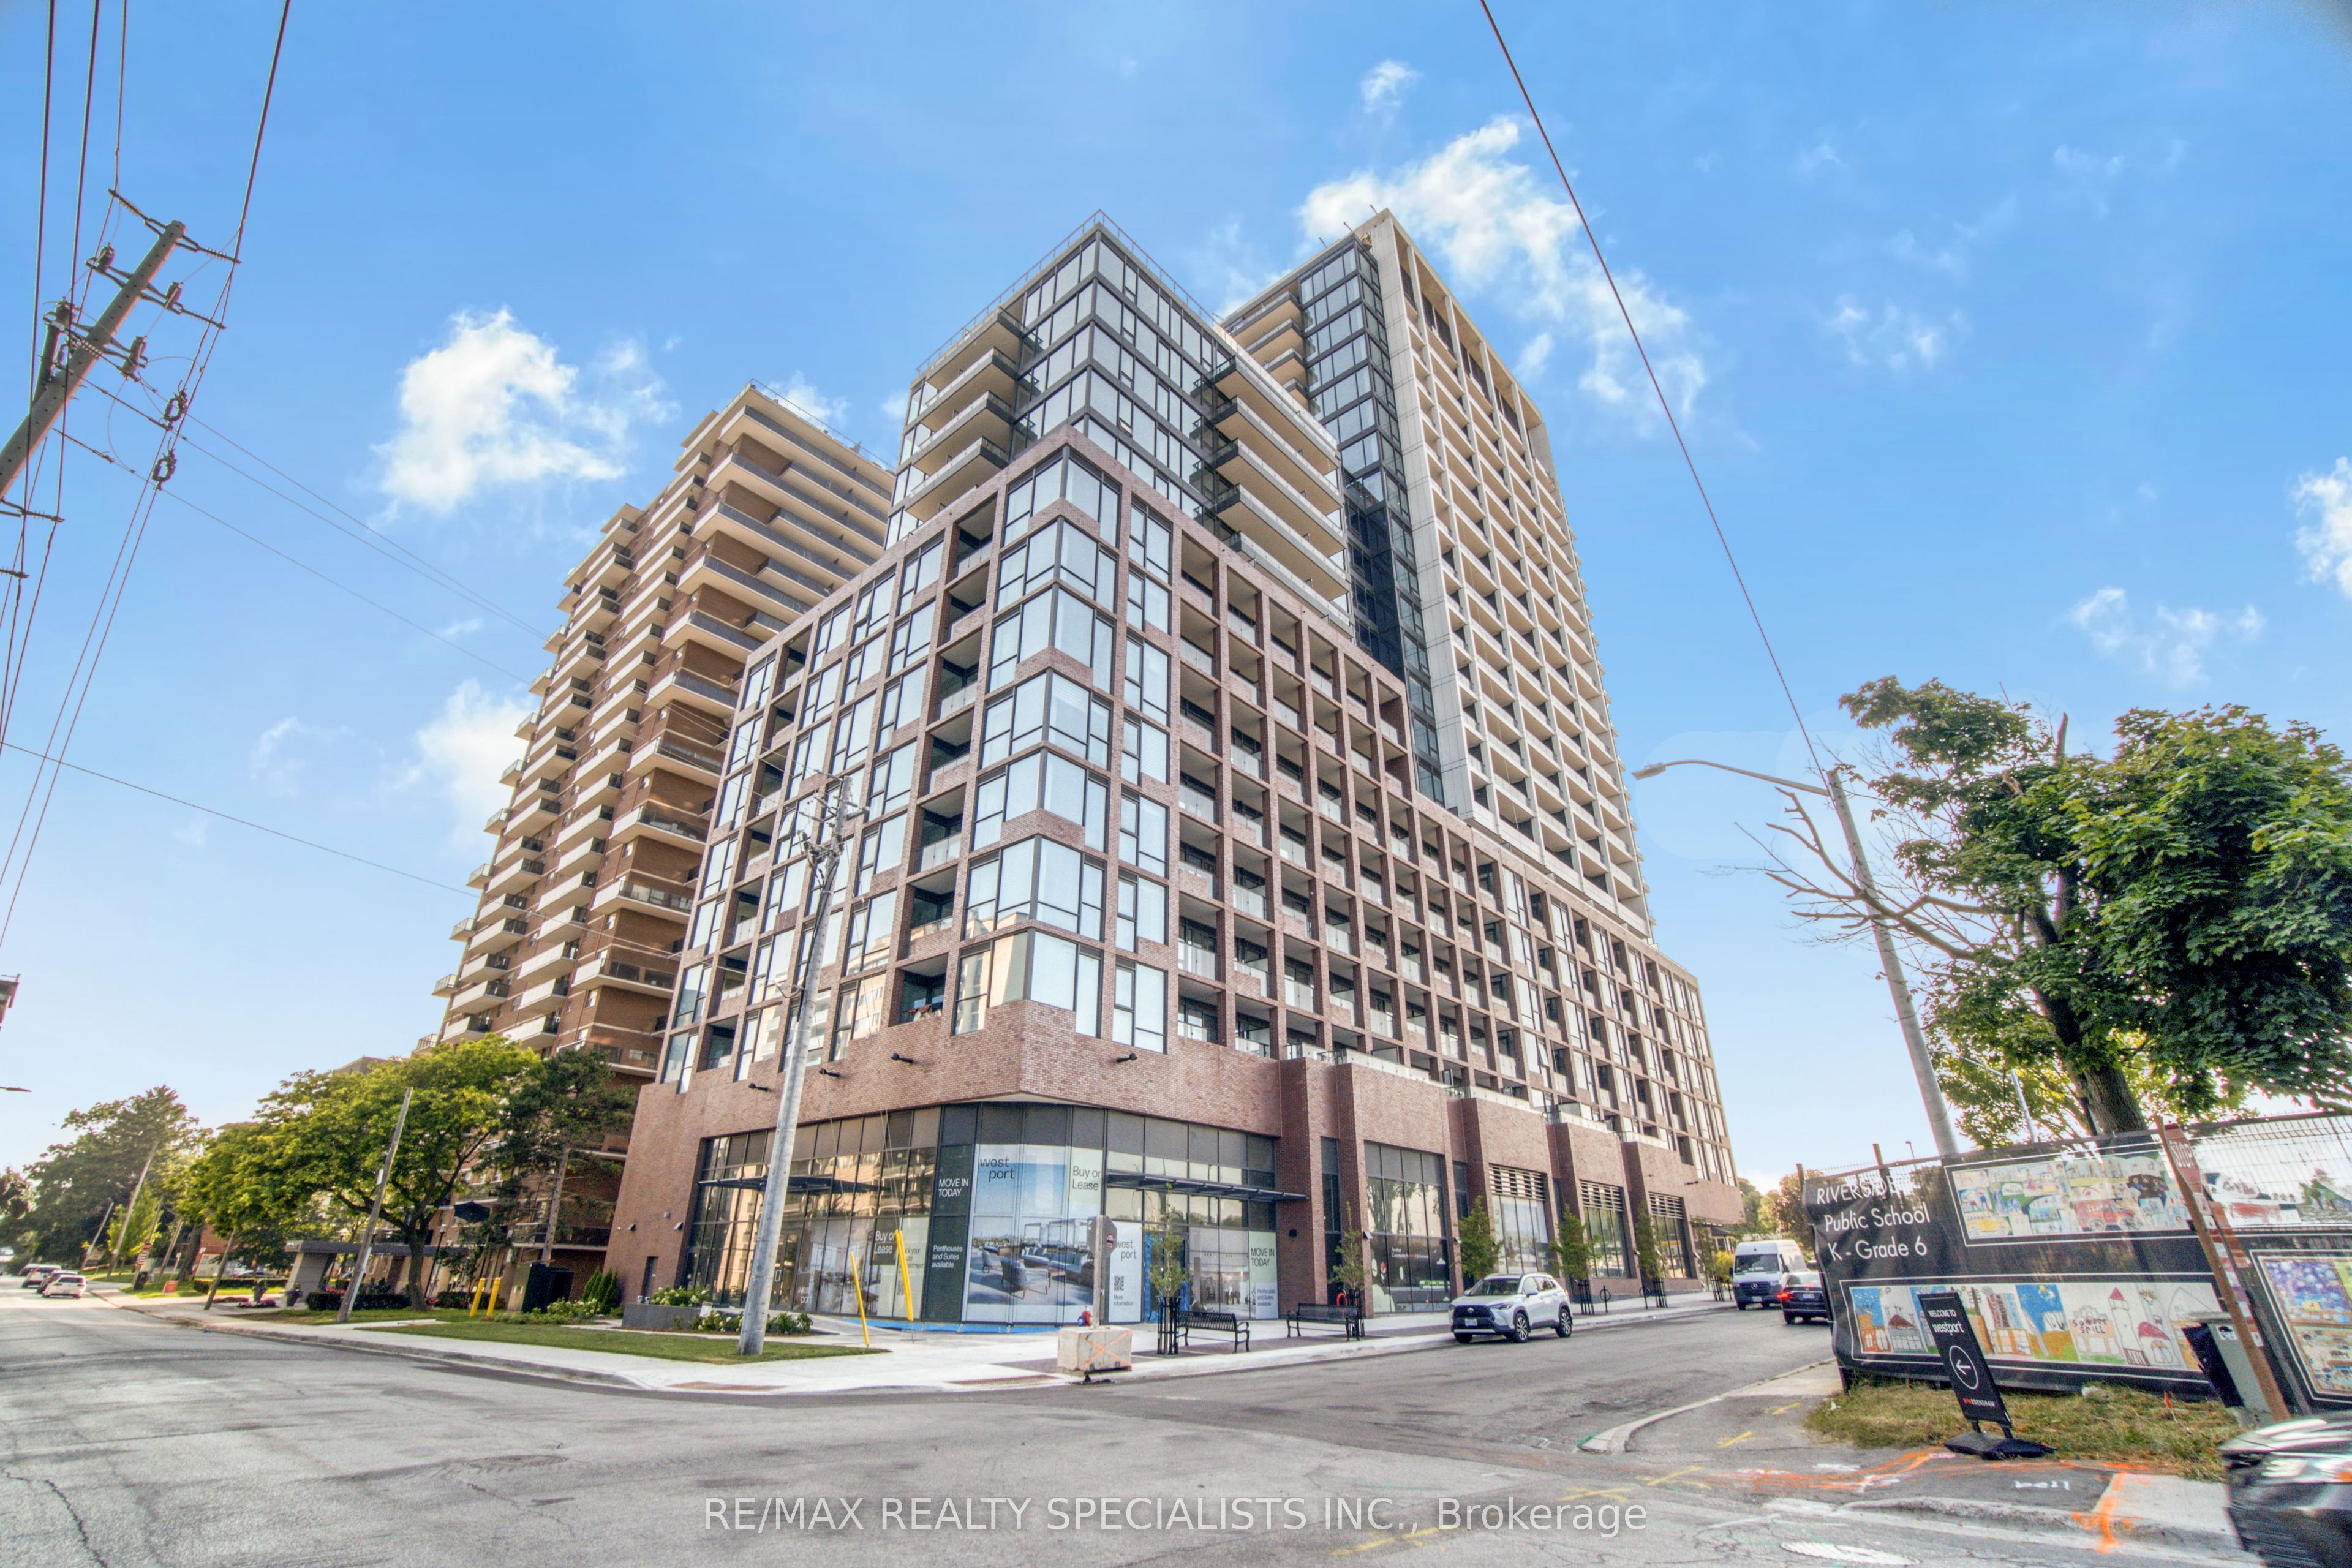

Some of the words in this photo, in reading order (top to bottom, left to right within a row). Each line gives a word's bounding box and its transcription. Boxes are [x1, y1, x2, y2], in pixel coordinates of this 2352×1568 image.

[2169, 1140, 2195, 1168] STOP
[980, 1157, 1009, 1167] west
[989, 1168, 1015, 1182] port
[1073, 1166, 1090, 1180] Buy
[938, 1178, 960, 1187] MOVE
[962, 1178, 969, 1186] IN
[1072, 1178, 1099, 1191] Lease
[938, 1188, 962, 1197] TODAY
[1824, 1210, 1869, 1232] Public
[1871, 1202, 1930, 1227] School
[875, 1231, 888, 1243] Buy
[873, 1243, 893, 1254] Lease
[1116, 1240, 1133, 1249] west
[1828, 1242, 1843, 1261] K
[1855, 1236, 1909, 1259] Grade
[1915, 1235, 1928, 1256] 6
[1121, 1250, 1137, 1261] port
[1251, 1257, 1270, 1267] TODAY
[1932, 1321, 1965, 1336] westport
